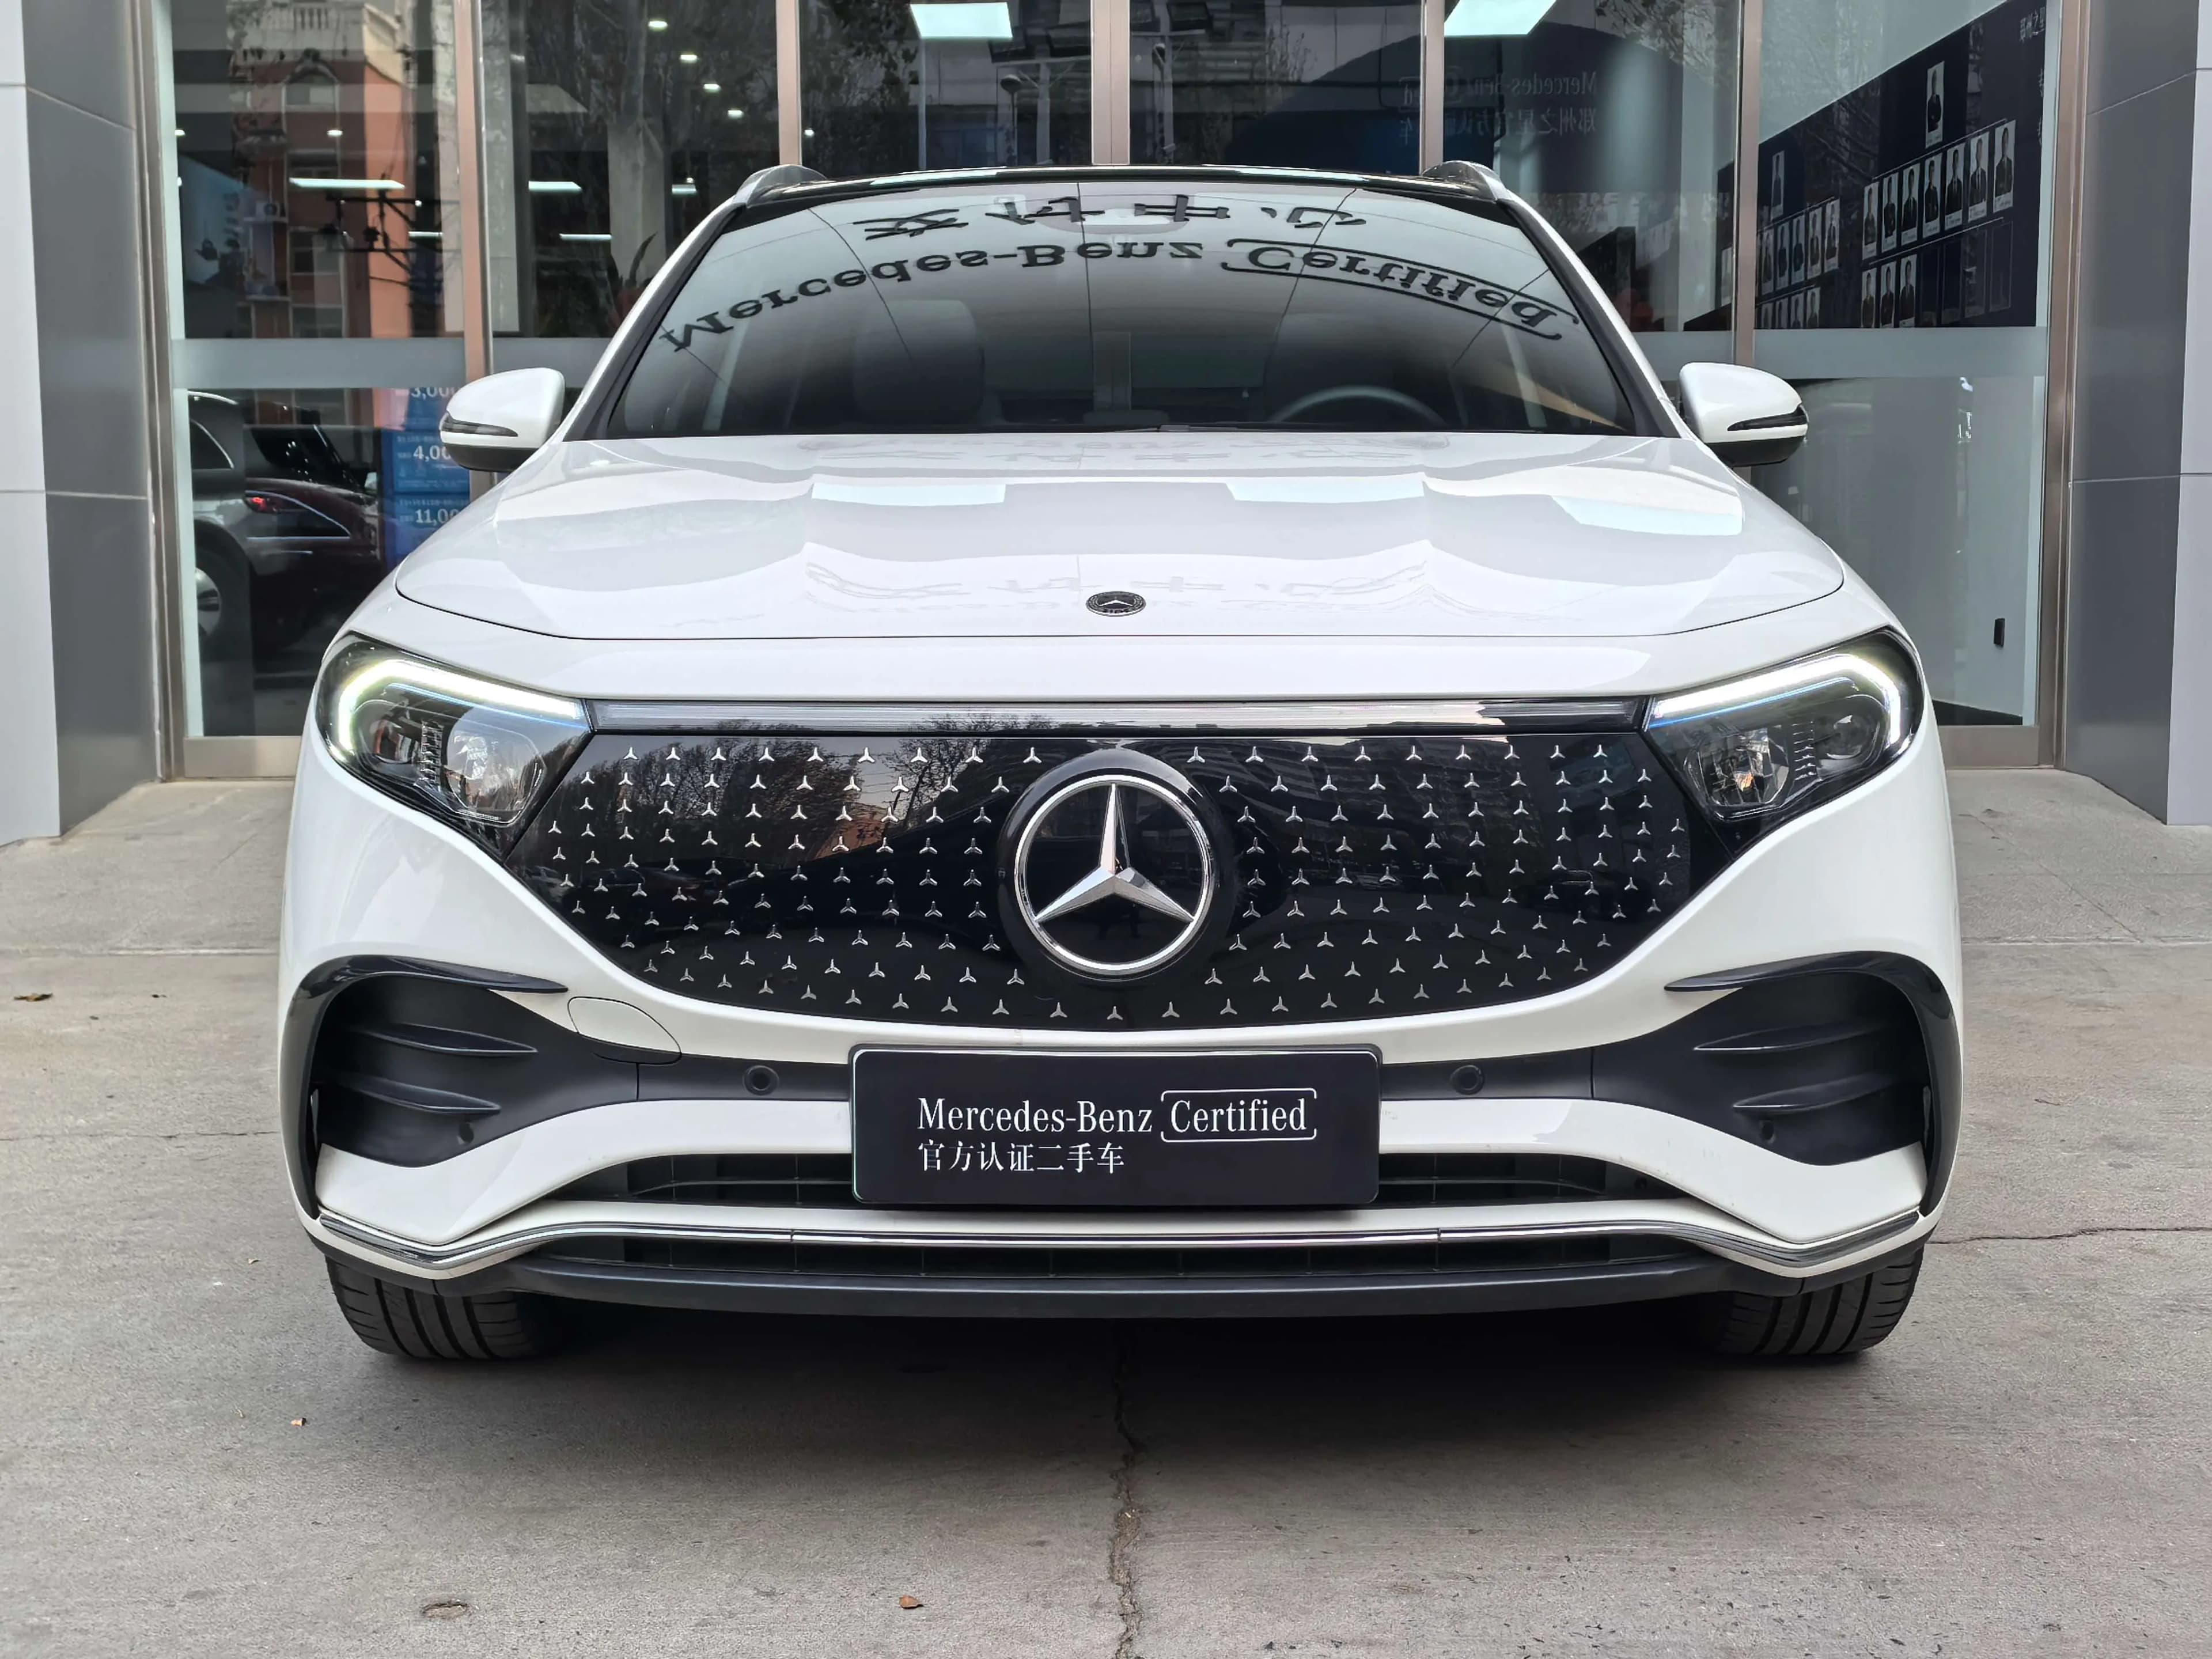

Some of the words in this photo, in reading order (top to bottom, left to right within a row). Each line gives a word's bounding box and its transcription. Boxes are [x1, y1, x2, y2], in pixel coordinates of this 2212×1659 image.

[918, 1097, 1153, 1133] Mercedes-Benz
[1171, 1098, 1307, 1132] Certified
[918, 1139, 1124, 1174] 官方认证二手车
